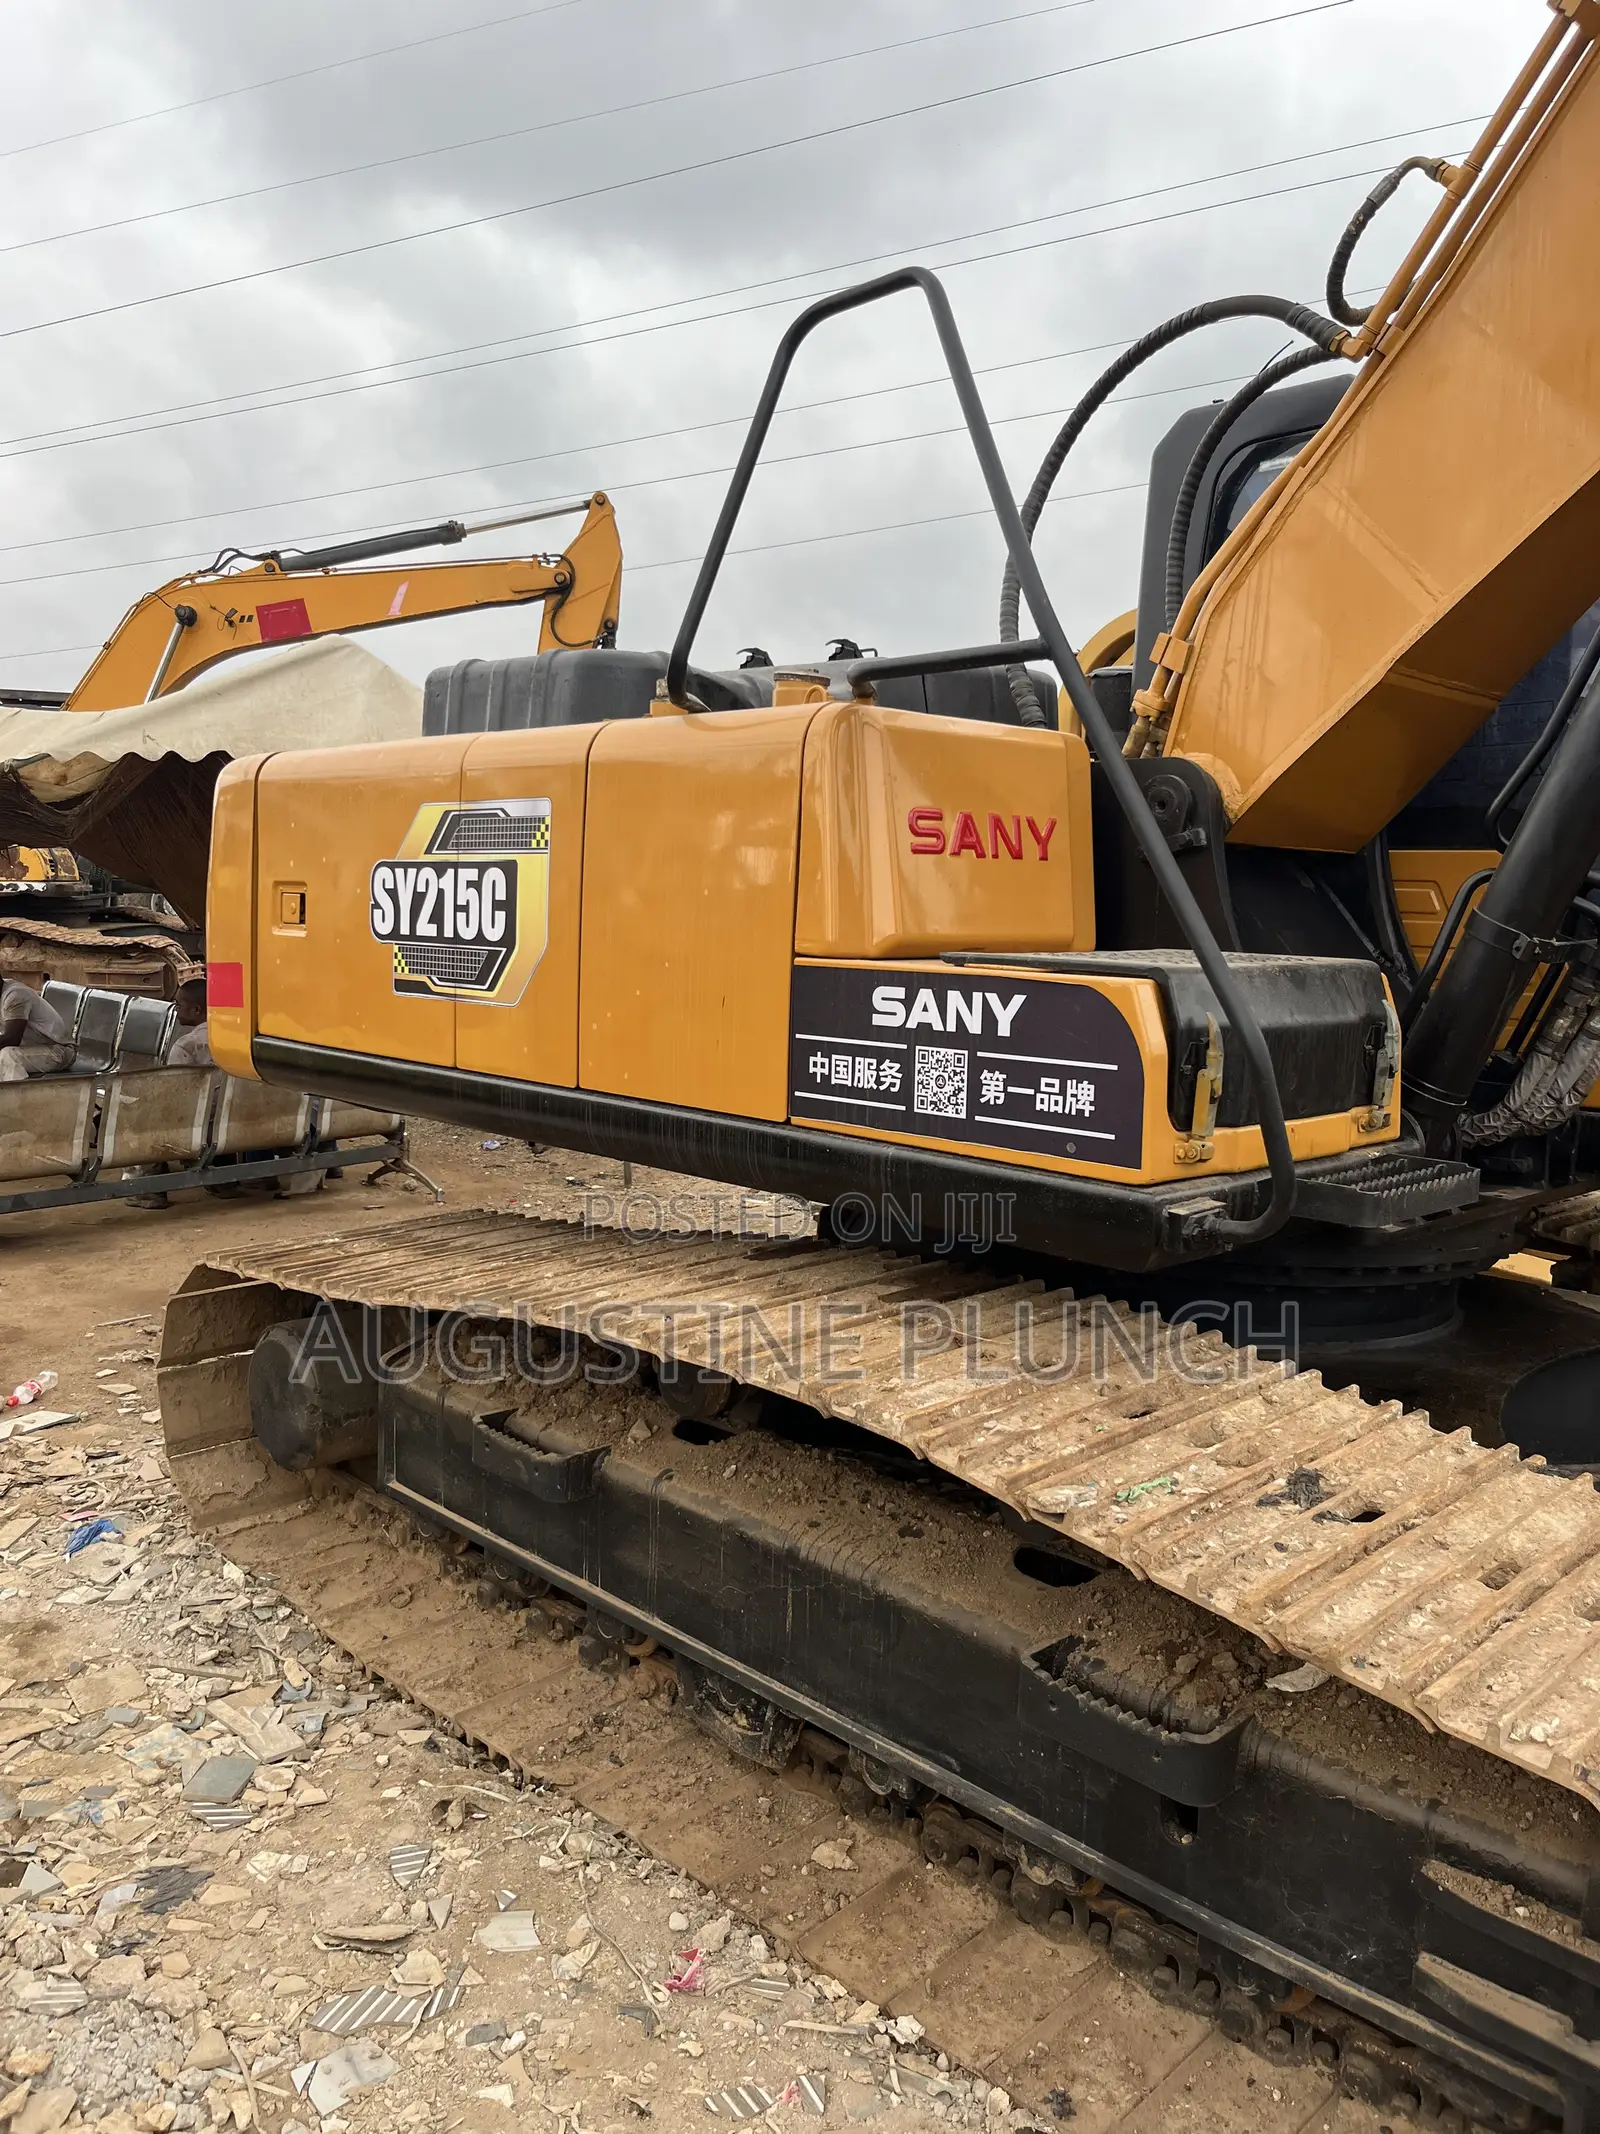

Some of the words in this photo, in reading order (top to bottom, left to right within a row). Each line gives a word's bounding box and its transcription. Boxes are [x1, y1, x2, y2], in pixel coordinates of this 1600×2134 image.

[908, 807, 1057, 861] SANY
[373, 866, 507, 941] SY215C
[872, 985, 1027, 1037] SANY
[808, 1051, 904, 1093] 中国服务
[979, 1070, 1096, 1118] 第一品牌
